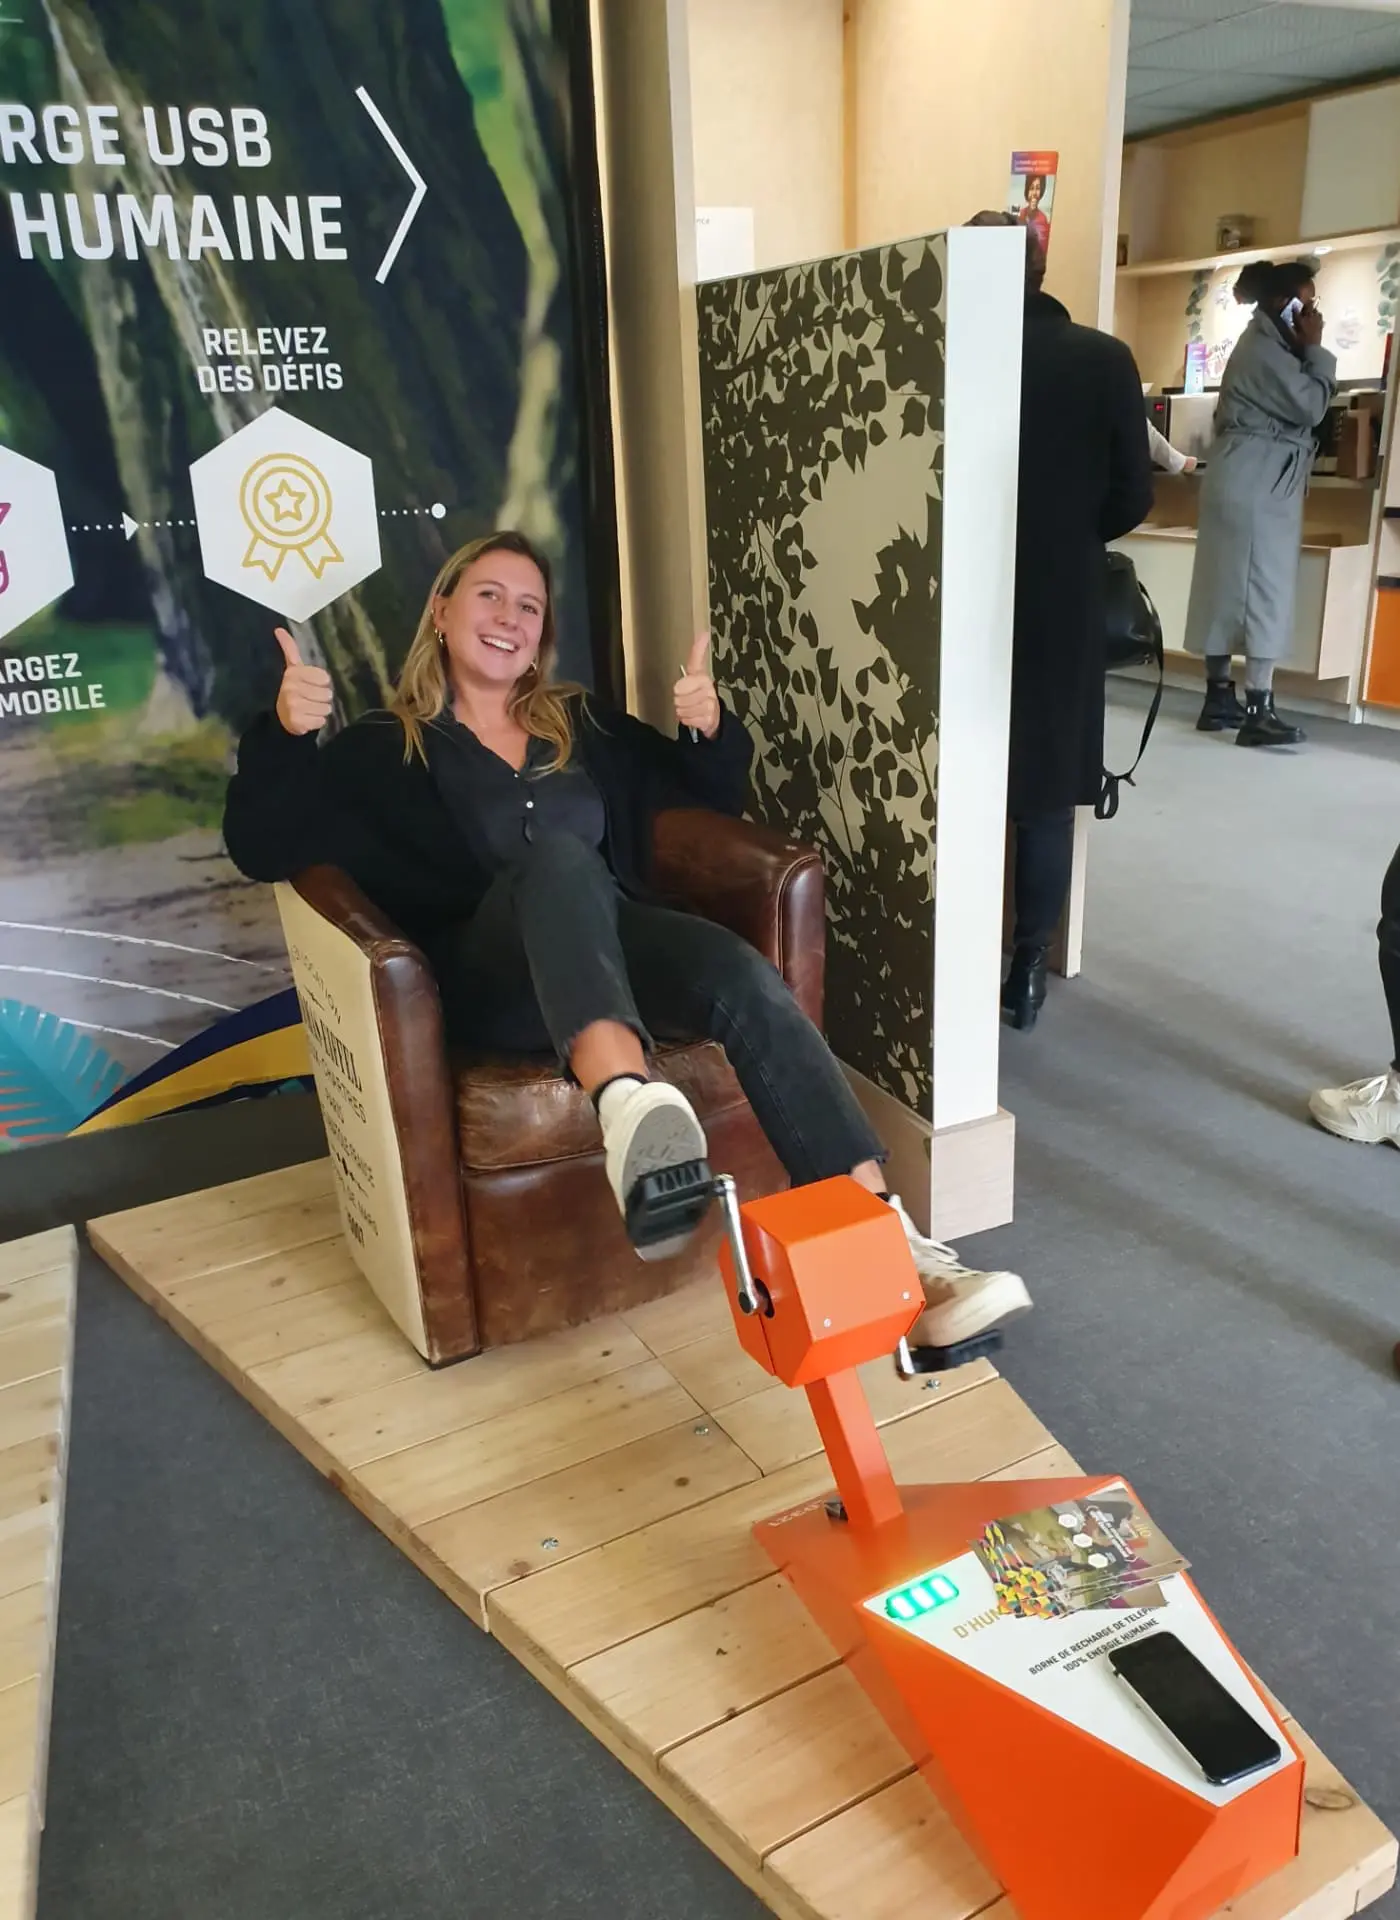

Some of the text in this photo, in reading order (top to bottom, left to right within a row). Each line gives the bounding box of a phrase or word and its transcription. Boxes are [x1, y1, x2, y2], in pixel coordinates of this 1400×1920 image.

[0, 104, 272, 168] RGE USB
[9, 192, 349, 261] HUMAINE
[202, 327, 330, 355] RELEVEZ
[197, 356, 344, 393] DES DÉFIS
[0, 683, 107, 718] MOBILE
[1028, 1655, 1060, 1675] BORNE
[1057, 1648, 1073, 1660] DE
[1069, 1625, 1115, 1653] RECHARGE
[1111, 1619, 1127, 1631] DE
[1062, 1656, 1089, 1672] 100%
[1119, 1617, 1160, 1641] HUMAINE
